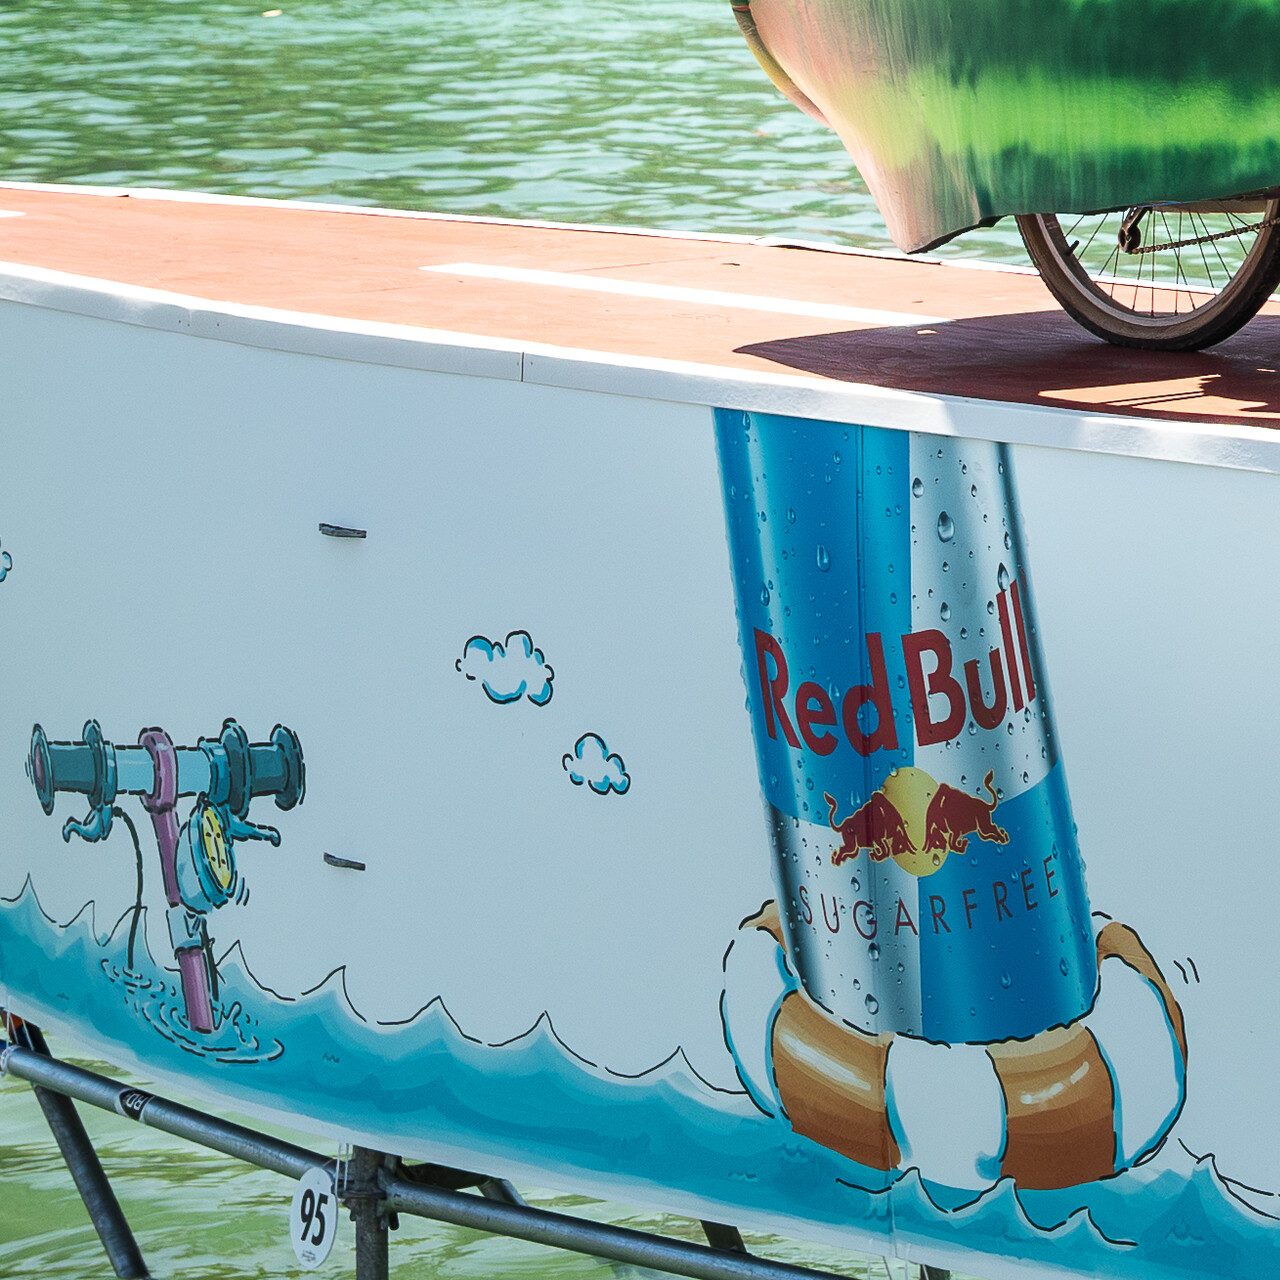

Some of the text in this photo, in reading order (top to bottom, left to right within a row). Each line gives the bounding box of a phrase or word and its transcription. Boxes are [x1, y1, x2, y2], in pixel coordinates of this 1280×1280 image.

[754, 579, 1036, 758] Red Bull
[798, 854, 1059, 941] SUGARFREE
[300, 1188, 329, 1247] 95
